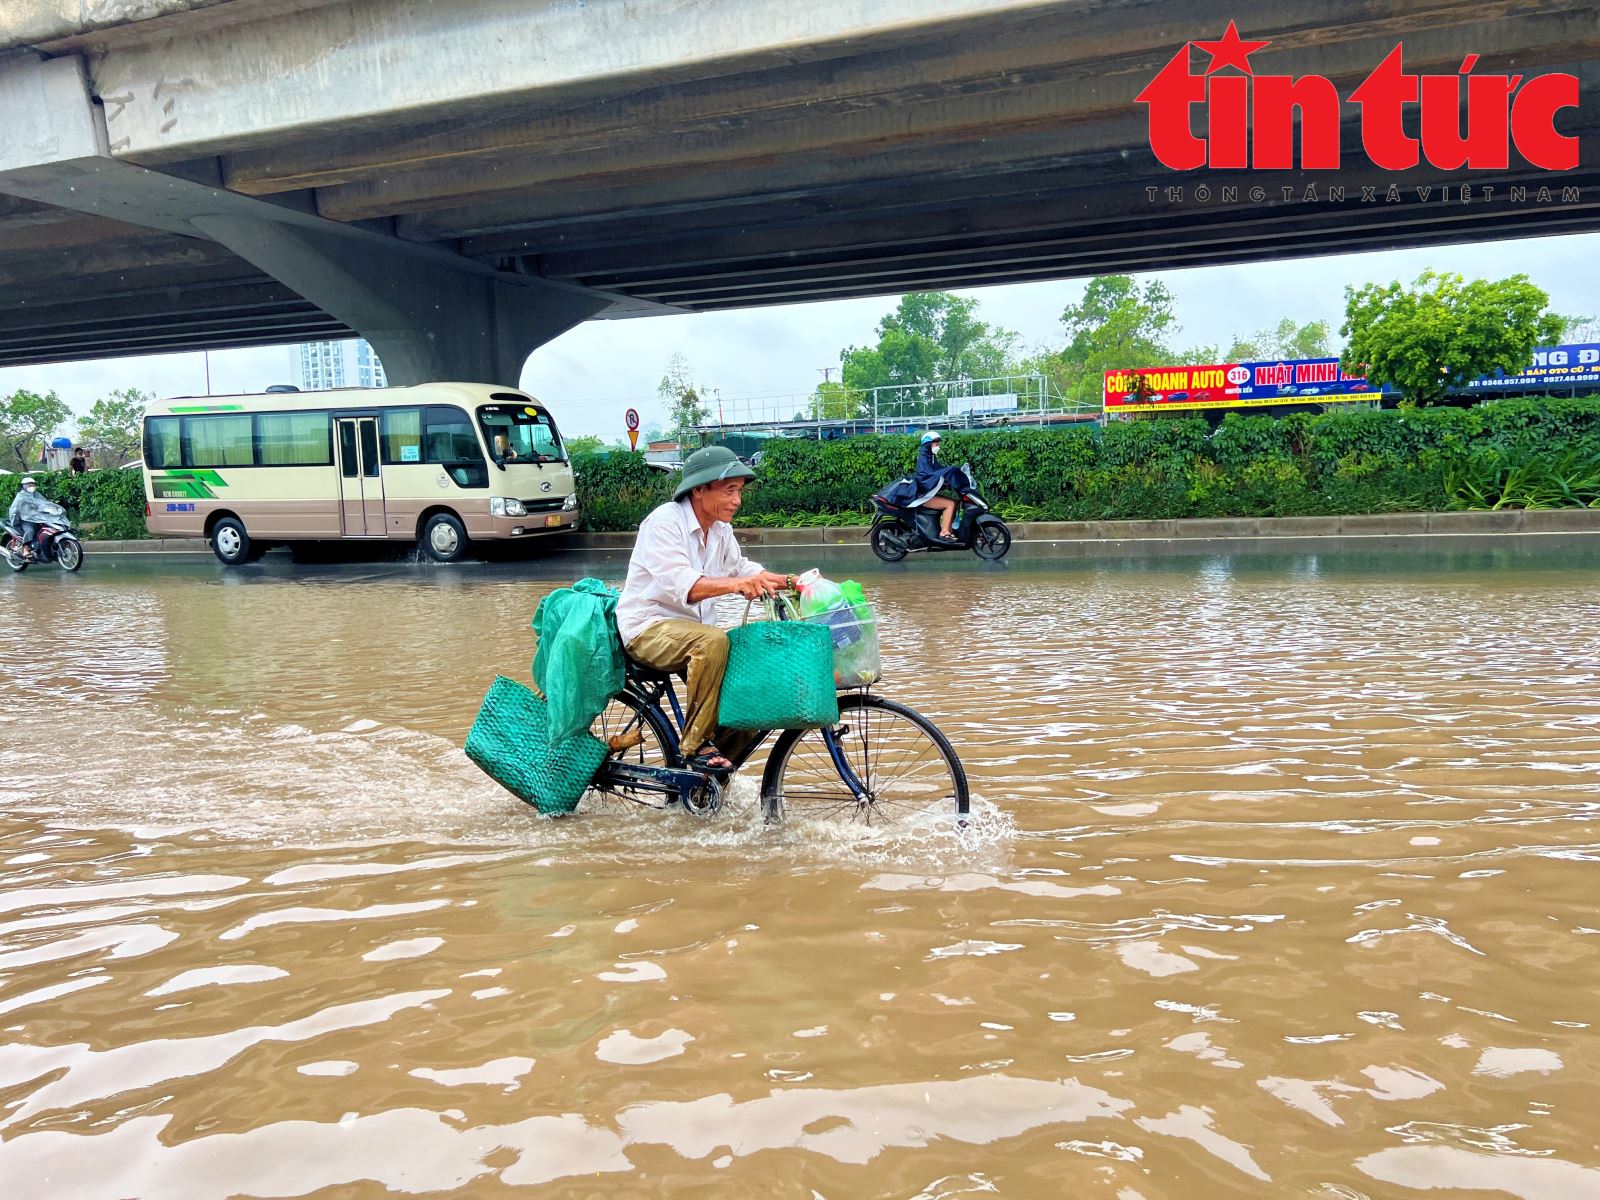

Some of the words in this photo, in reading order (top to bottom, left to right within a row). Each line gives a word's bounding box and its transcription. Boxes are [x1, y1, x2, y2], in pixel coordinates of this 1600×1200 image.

[1191, 369, 1225, 389] AUTO
[1230, 370, 1248, 381] 316
[1254, 363, 1294, 388] NHẬT
[1296, 362, 1338, 383] MINH
